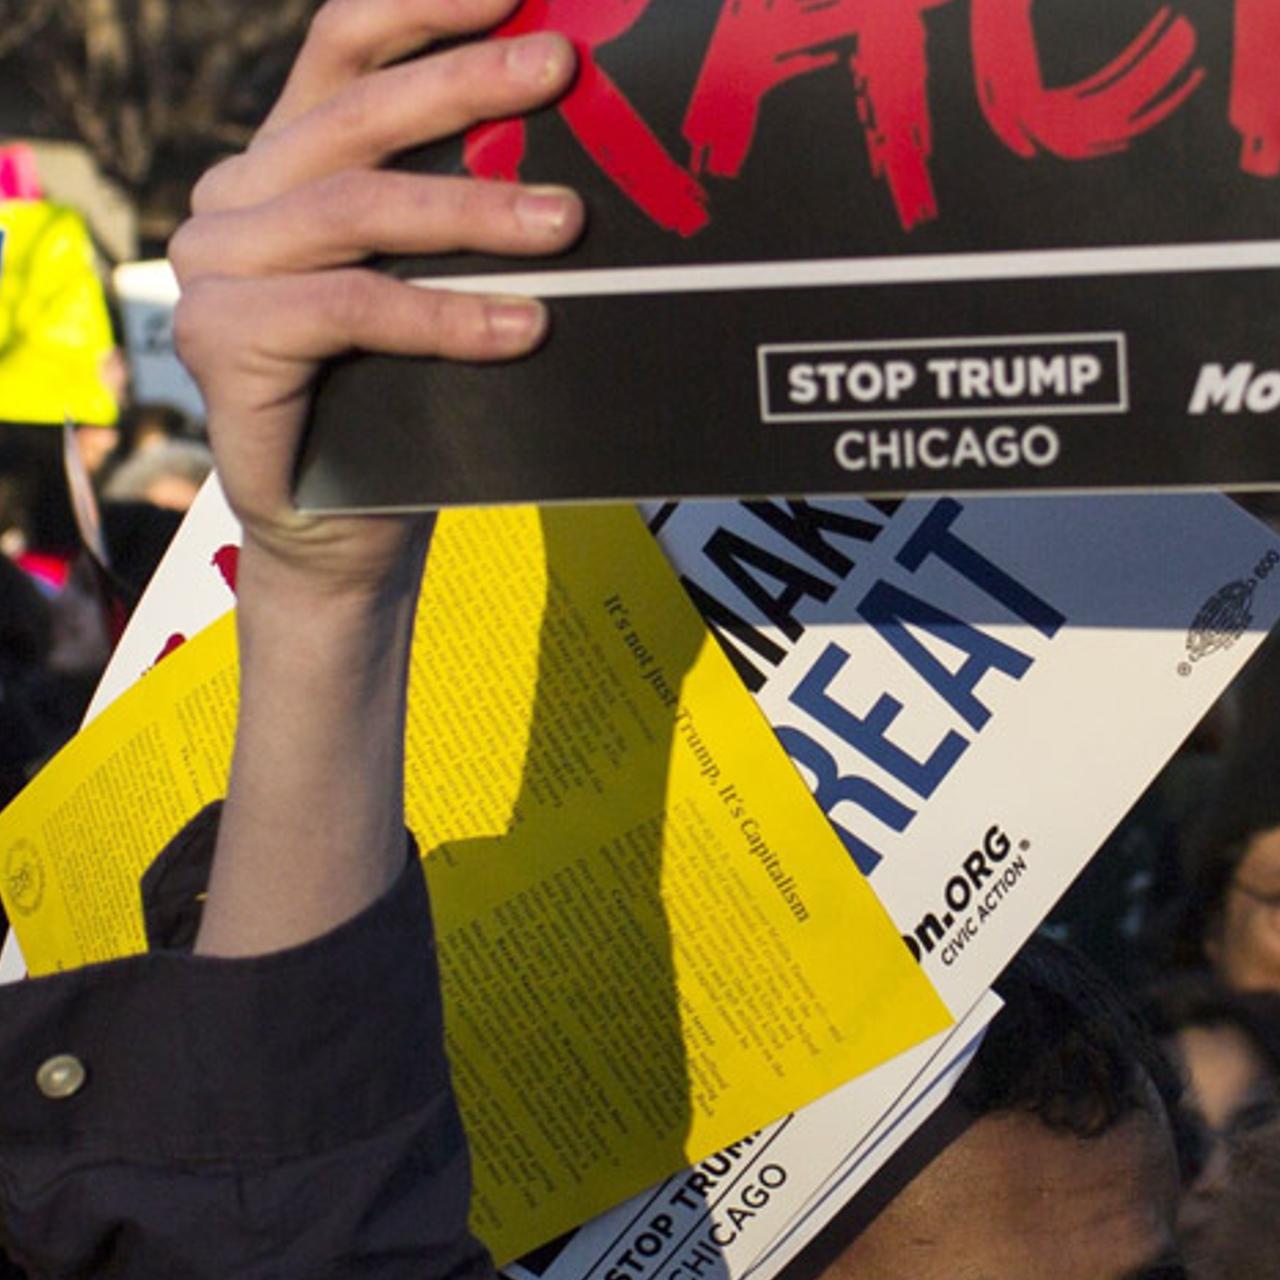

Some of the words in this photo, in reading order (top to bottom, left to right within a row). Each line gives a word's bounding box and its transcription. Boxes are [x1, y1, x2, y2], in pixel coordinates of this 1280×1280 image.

[788, 361, 916, 403] STOP
[927, 355, 1102, 399] TRUMP
[834, 425, 1060, 471] CHICAGO
[603, 594, 632, 631] It's
[623, 630, 655, 668] not
[640, 666, 679, 708] just
[669, 708, 721, 787] Trump,
[718, 783, 745, 820] It's
[739, 818, 810, 924] Capitalism
[940, 916, 979, 967] CIVIC
[975, 855, 1028, 924] ACTION
